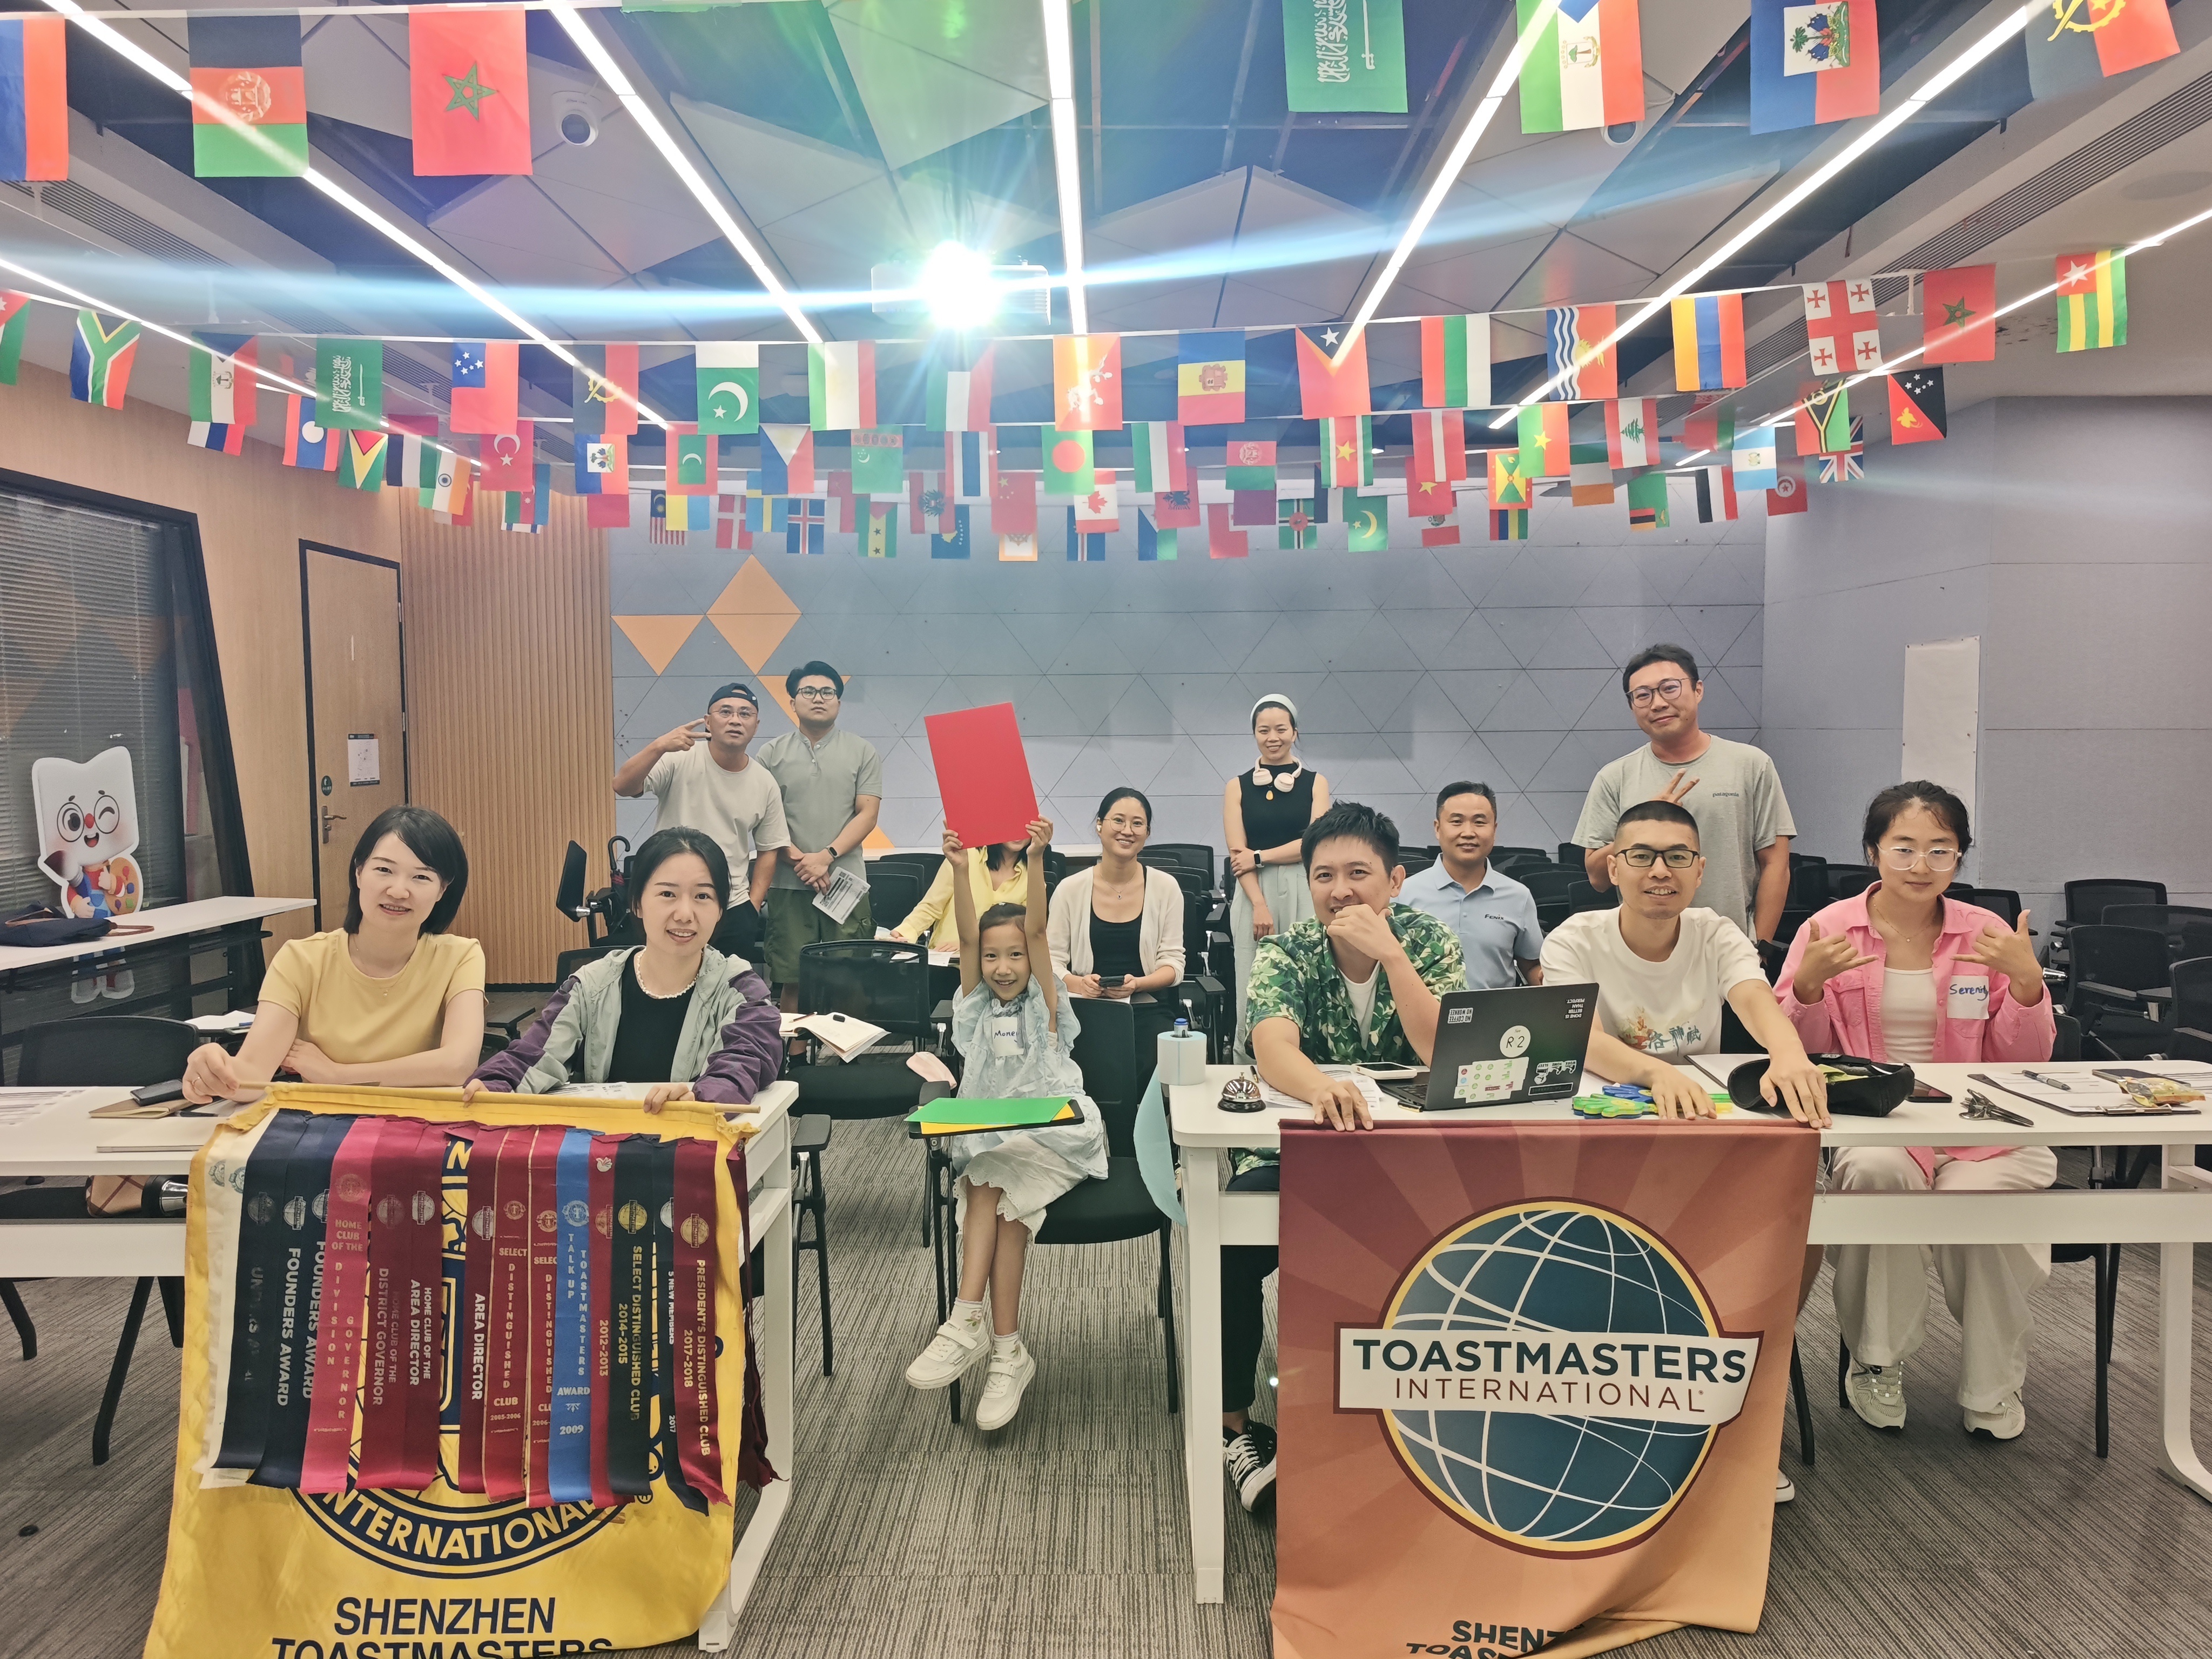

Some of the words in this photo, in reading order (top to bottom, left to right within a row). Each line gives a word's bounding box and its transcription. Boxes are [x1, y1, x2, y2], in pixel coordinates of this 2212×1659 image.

[1950, 984, 1989, 1001] Serenity
[1506, 1036, 1514, 1048] R
[1517, 1036, 1525, 1048] 2
[335, 1219, 362, 1230] HOME
[336, 1231, 360, 1240] CLUB
[332, 1242, 343, 1251] OF
[346, 1242, 363, 1251] THE
[499, 1247, 528, 1257] SELECT
[534, 1256, 557, 1265] SELEC
[308, 1241, 326, 1331] FOUNDERS
[632, 1245, 642, 1291] SELECT
[281, 1247, 301, 1339] FOUNDERS
[377, 1268, 389, 1327] DISTRICT
[410, 1279, 420, 1316] AREA
[568, 1279, 575, 1299] UP
[697, 1259, 706, 1333] PRESIDENT'S
[327, 1262, 343, 1365] DIVISION
[474, 1293, 485, 1330] AREA
[503, 1263, 516, 1388] DISTINGUISHED
[578, 1250, 588, 1375] TOASTMASTERS
[390, 1321, 399, 1346] CLUB
[409, 1319, 420, 1385] DIRECTOR
[423, 1345, 431, 1358] OF
[599, 1319, 609, 1377] 2012-2013
[618, 1303, 628, 1364] 2014-2015
[631, 1294, 642, 1386] DISTINGUISHED
[277, 1343, 292, 1406] AWARD
[302, 1336, 317, 1399] AWARD
[338, 1316, 354, 1419] GOVERNOR
[373, 1331, 387, 1405] GOVERNOR
[388, 1364, 397, 1383] THE
[389, 1349, 397, 1362] OF
[423, 1360, 431, 1379] THE
[471, 1333, 484, 1400] DIRECTOR
[683, 1329, 693, 1388] 2017-2018
[1352, 1339, 1748, 1384] TOASTMASTERS
[557, 1387, 590, 1396] AWARD
[697, 1336, 709, 1423] DISTINGUISHED
[1395, 1377, 1705, 1413] INTERNATIONAL
[494, 1397, 518, 1406] CLUB
[538, 1404, 551, 1412] CL
[630, 1389, 640, 1421] CLUB
[559, 1425, 584, 1435] 2009
[699, 1425, 711, 1456] CLUB
[322, 1489, 596, 1559] NTERNATIONA
[334, 1596, 556, 1635] SHENZHEN
